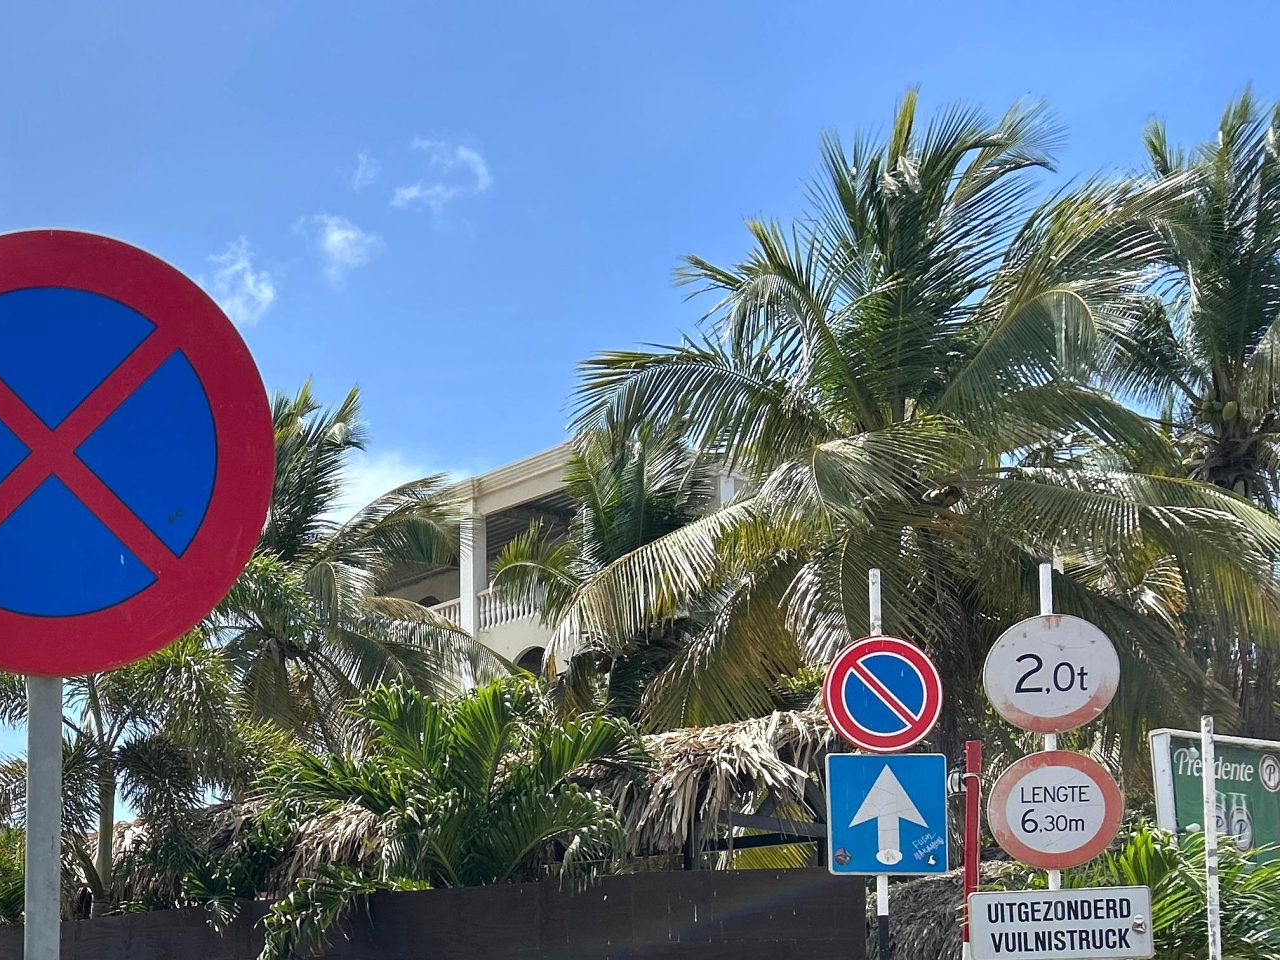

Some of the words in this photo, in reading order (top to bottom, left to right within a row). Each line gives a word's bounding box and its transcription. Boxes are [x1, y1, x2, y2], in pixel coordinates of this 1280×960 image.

[1015, 653, 1088, 694] 2,0t
[1173, 747, 1254, 782] Predente
[1021, 785, 1090, 804] LENGTE
[987, 898, 1131, 923] UITGEZONDERD
[991, 928, 1131, 953] VUILNISTRUCK
